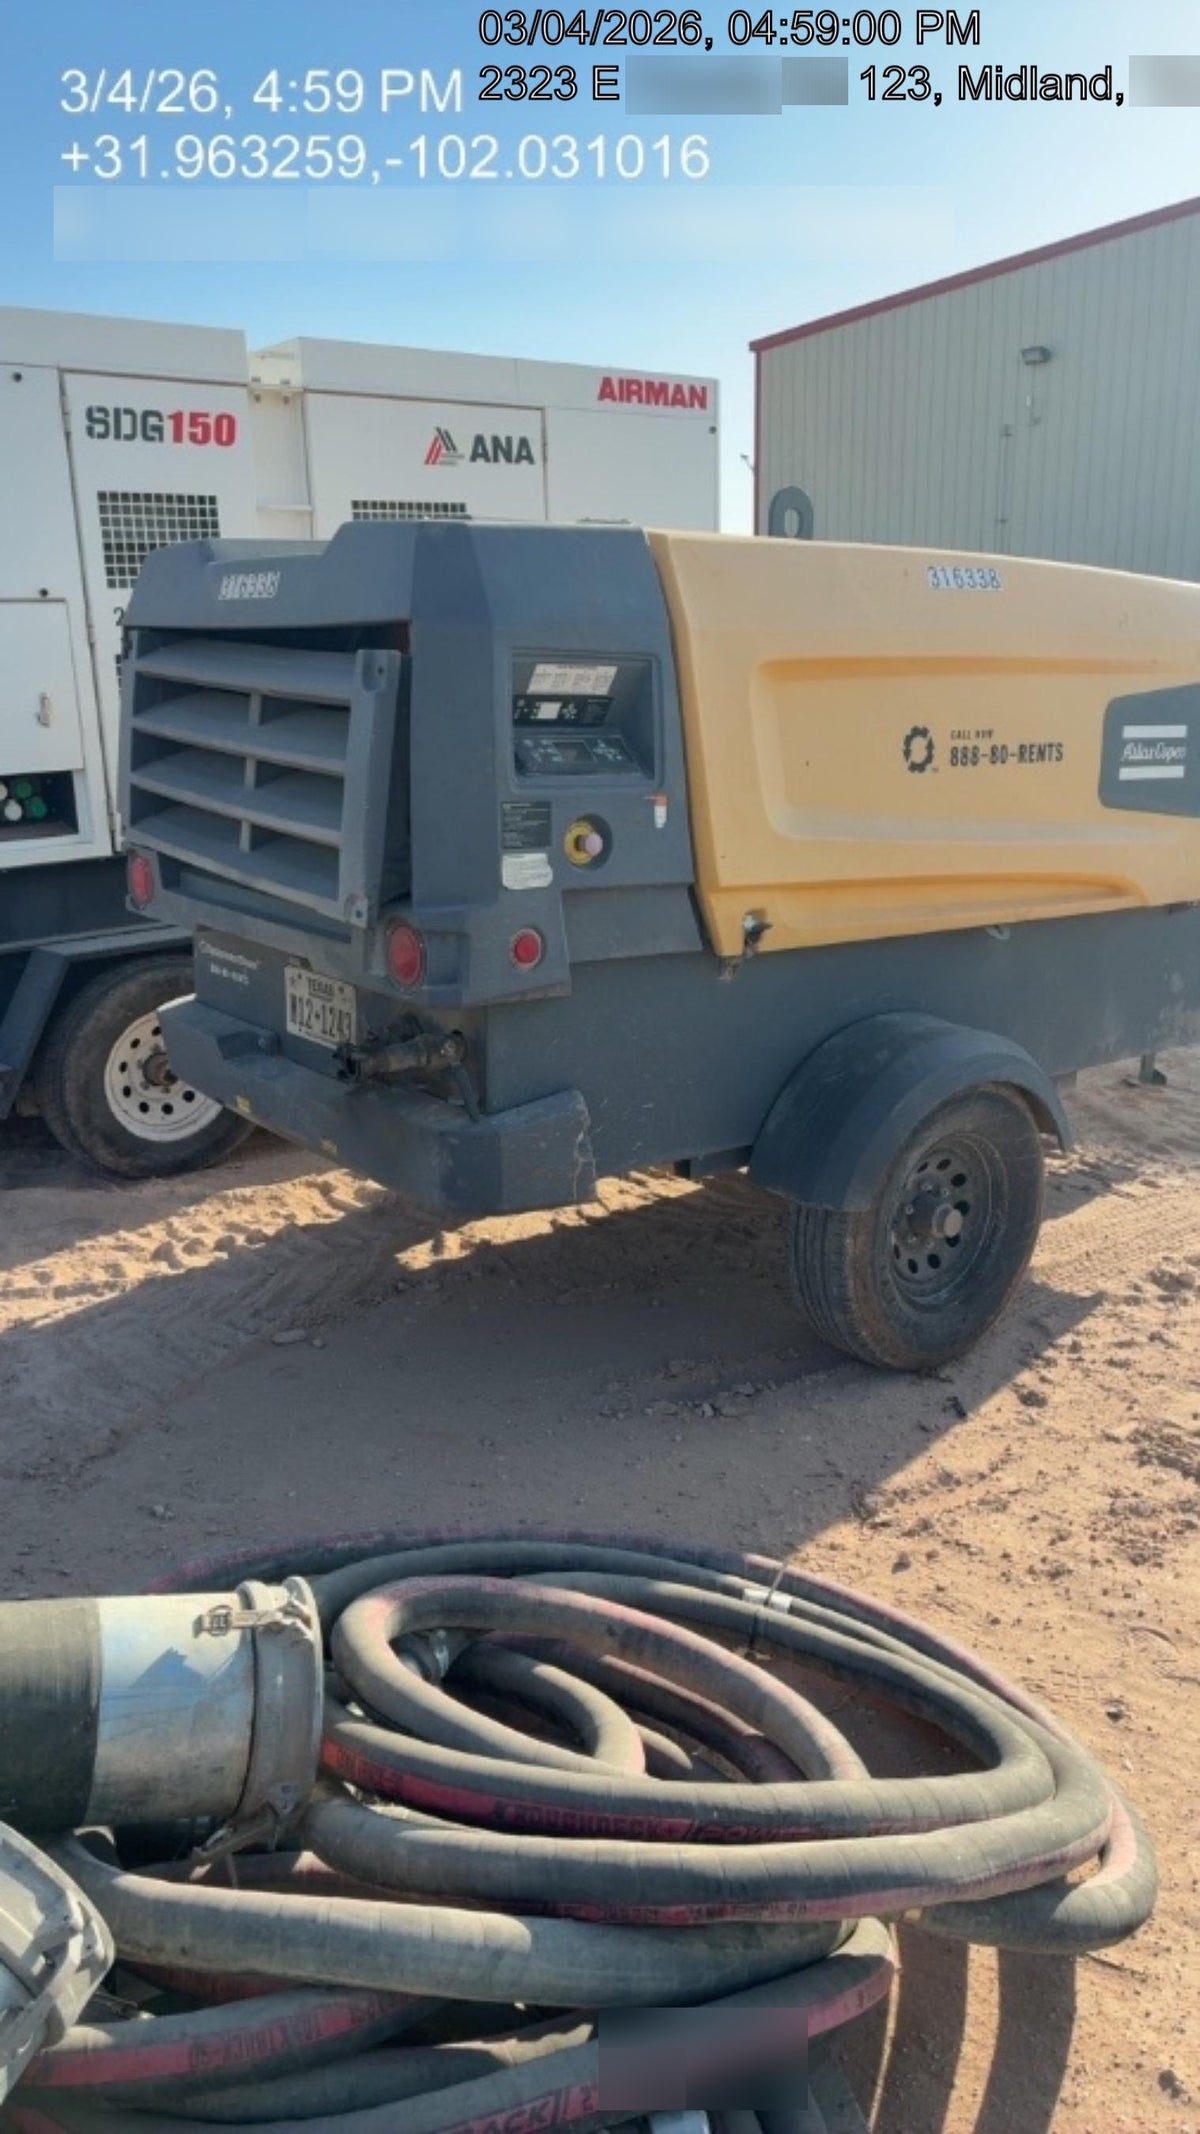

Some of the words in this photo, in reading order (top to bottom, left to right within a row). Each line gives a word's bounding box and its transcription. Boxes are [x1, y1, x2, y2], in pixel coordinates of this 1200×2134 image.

[597, 376, 708, 410] AIRMAN
[85, 405, 237, 447] SDG150
[469, 433, 535, 466] ANA
[926, 565, 1002, 590] 316338
[949, 742, 1064, 768] 888-80-RENTS
